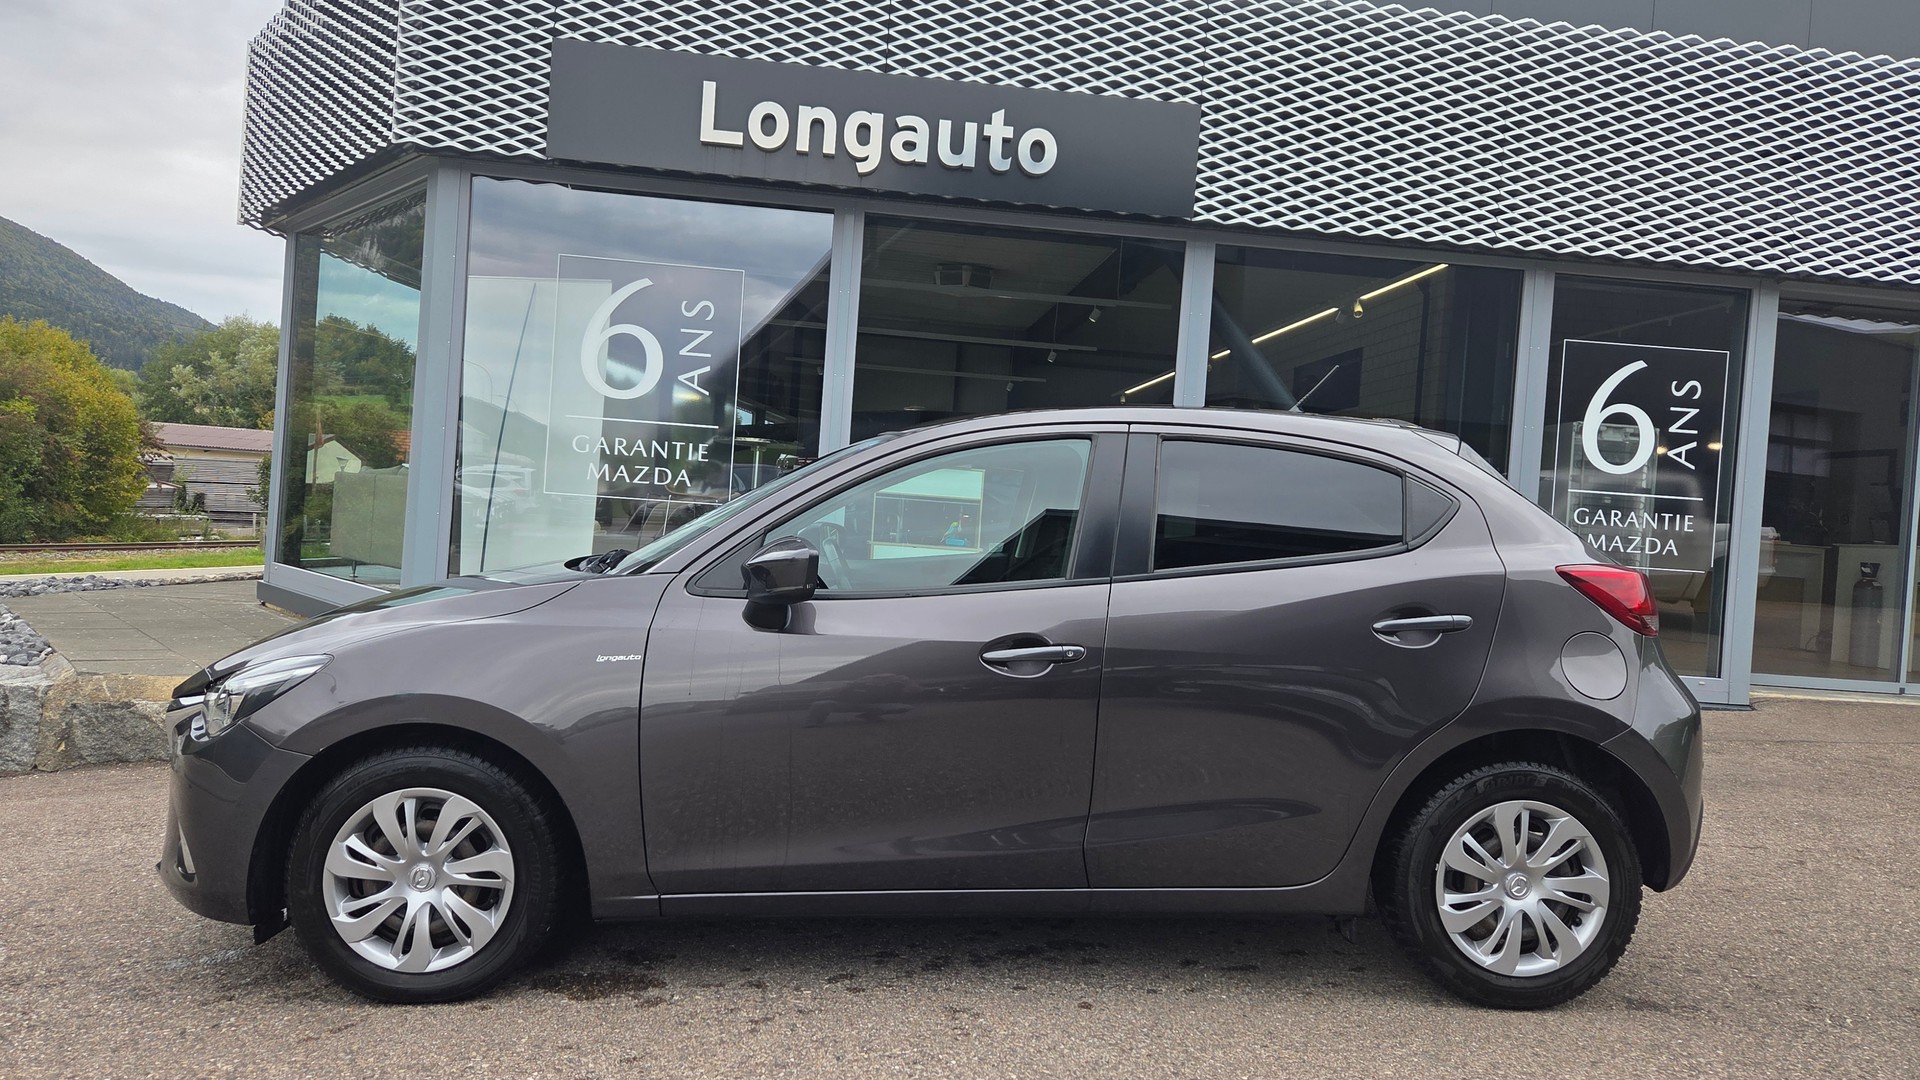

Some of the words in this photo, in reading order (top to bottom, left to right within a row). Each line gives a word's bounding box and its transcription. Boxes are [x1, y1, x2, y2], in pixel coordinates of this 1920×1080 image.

[700, 80, 1058, 176] Longauto
[580, 277, 664, 400] 6
[677, 299, 715, 396] ANS
[571, 434, 709, 462] GARANTIE
[1581, 359, 1656, 475] 6
[1667, 379, 1702, 470] ANS
[586, 463, 692, 487] MAZDA
[1573, 507, 1695, 533] GARANTIE
[1587, 533, 1679, 556] MAZDA
